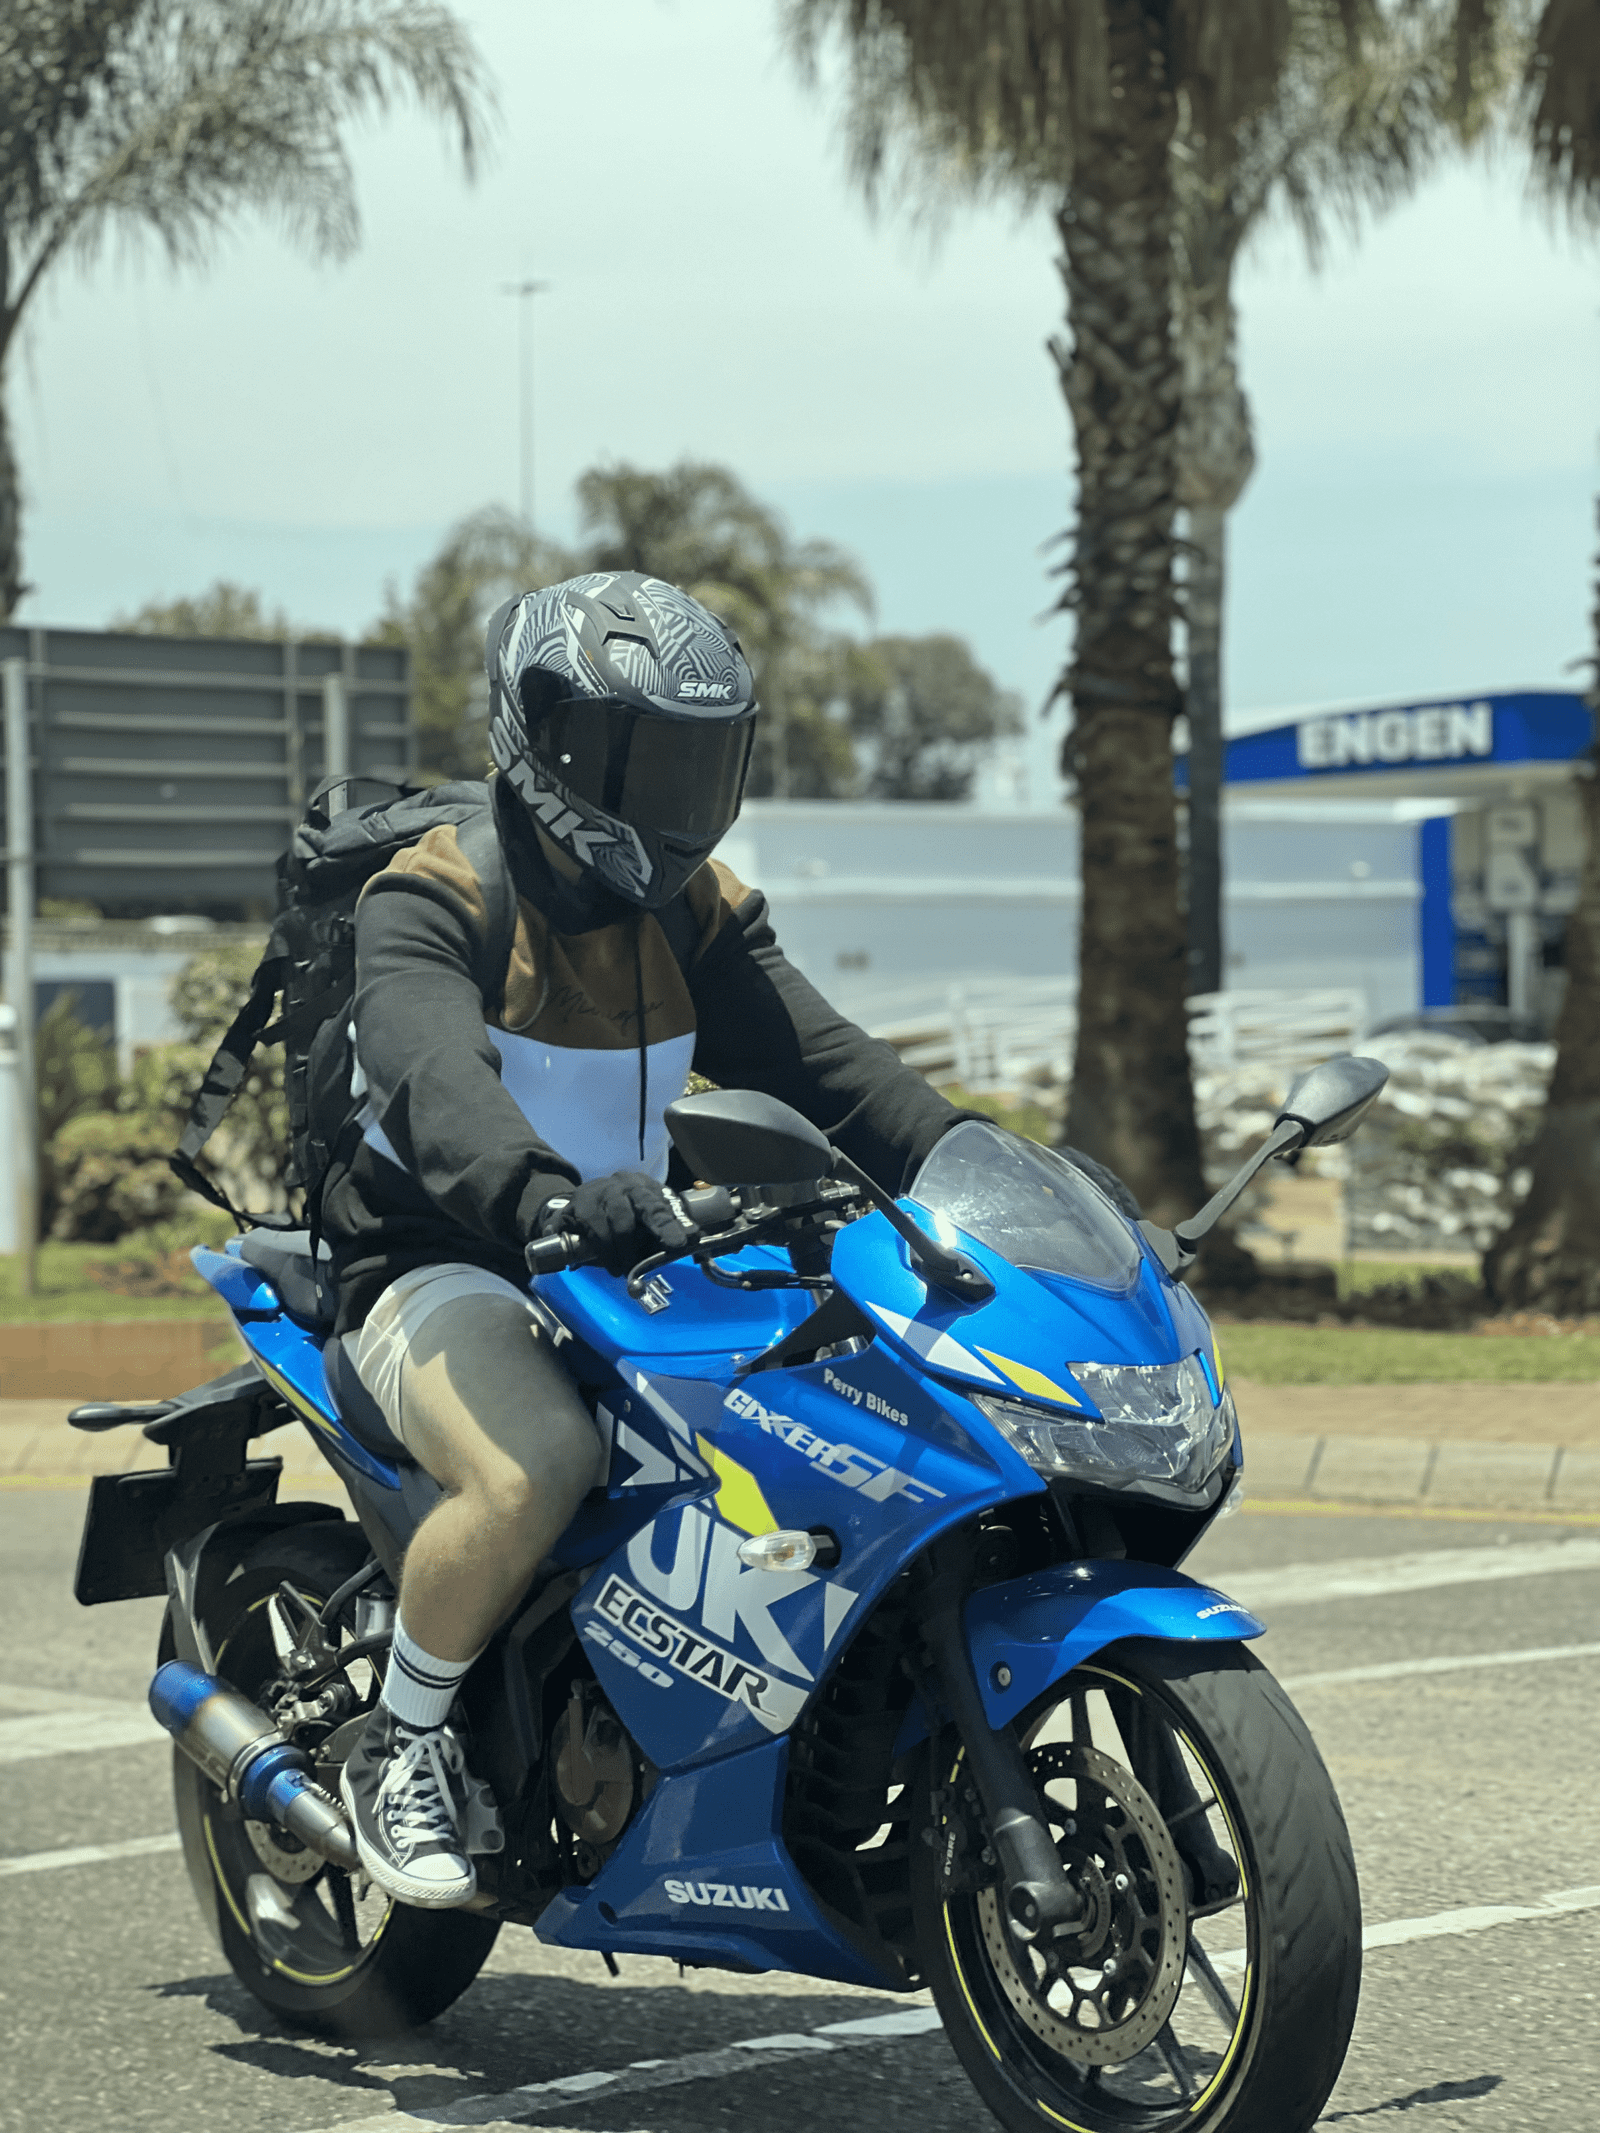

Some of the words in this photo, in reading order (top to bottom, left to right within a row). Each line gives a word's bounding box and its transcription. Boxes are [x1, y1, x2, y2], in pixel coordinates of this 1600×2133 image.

[678, 681, 733, 700] SMK
[1297, 701, 1492, 769] ENGEN
[823, 1367, 863, 1406] Perry
[866, 1391, 909, 1427] Bikes
[584, 1620, 675, 1688] 250
[599, 1578, 778, 1717] ECSTAR
[664, 1879, 790, 1912] SUZUKI
